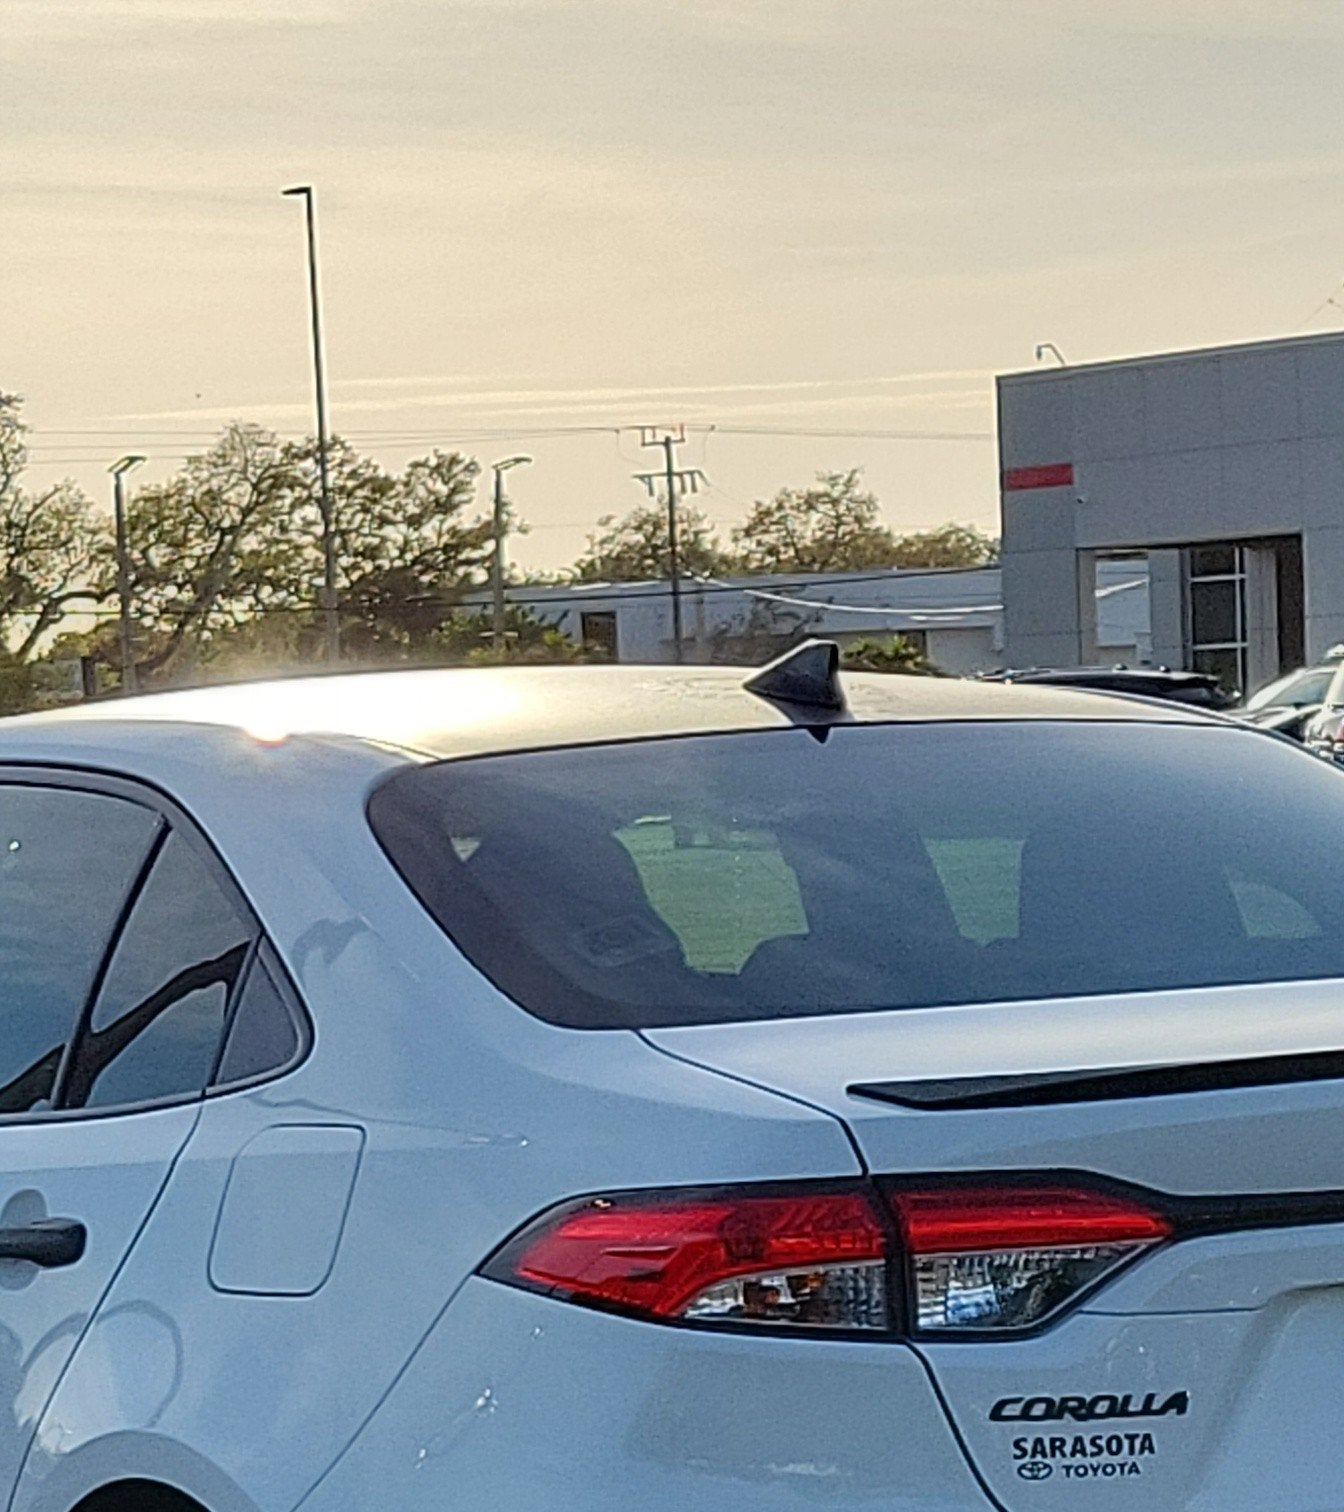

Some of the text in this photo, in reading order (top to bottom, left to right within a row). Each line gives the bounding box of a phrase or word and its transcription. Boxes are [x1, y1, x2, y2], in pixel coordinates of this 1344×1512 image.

[989, 1390, 1189, 1421] COROLLA
[1012, 1433, 1156, 1460] SARASOTA
[1062, 1461, 1141, 1478] TOYOTA
